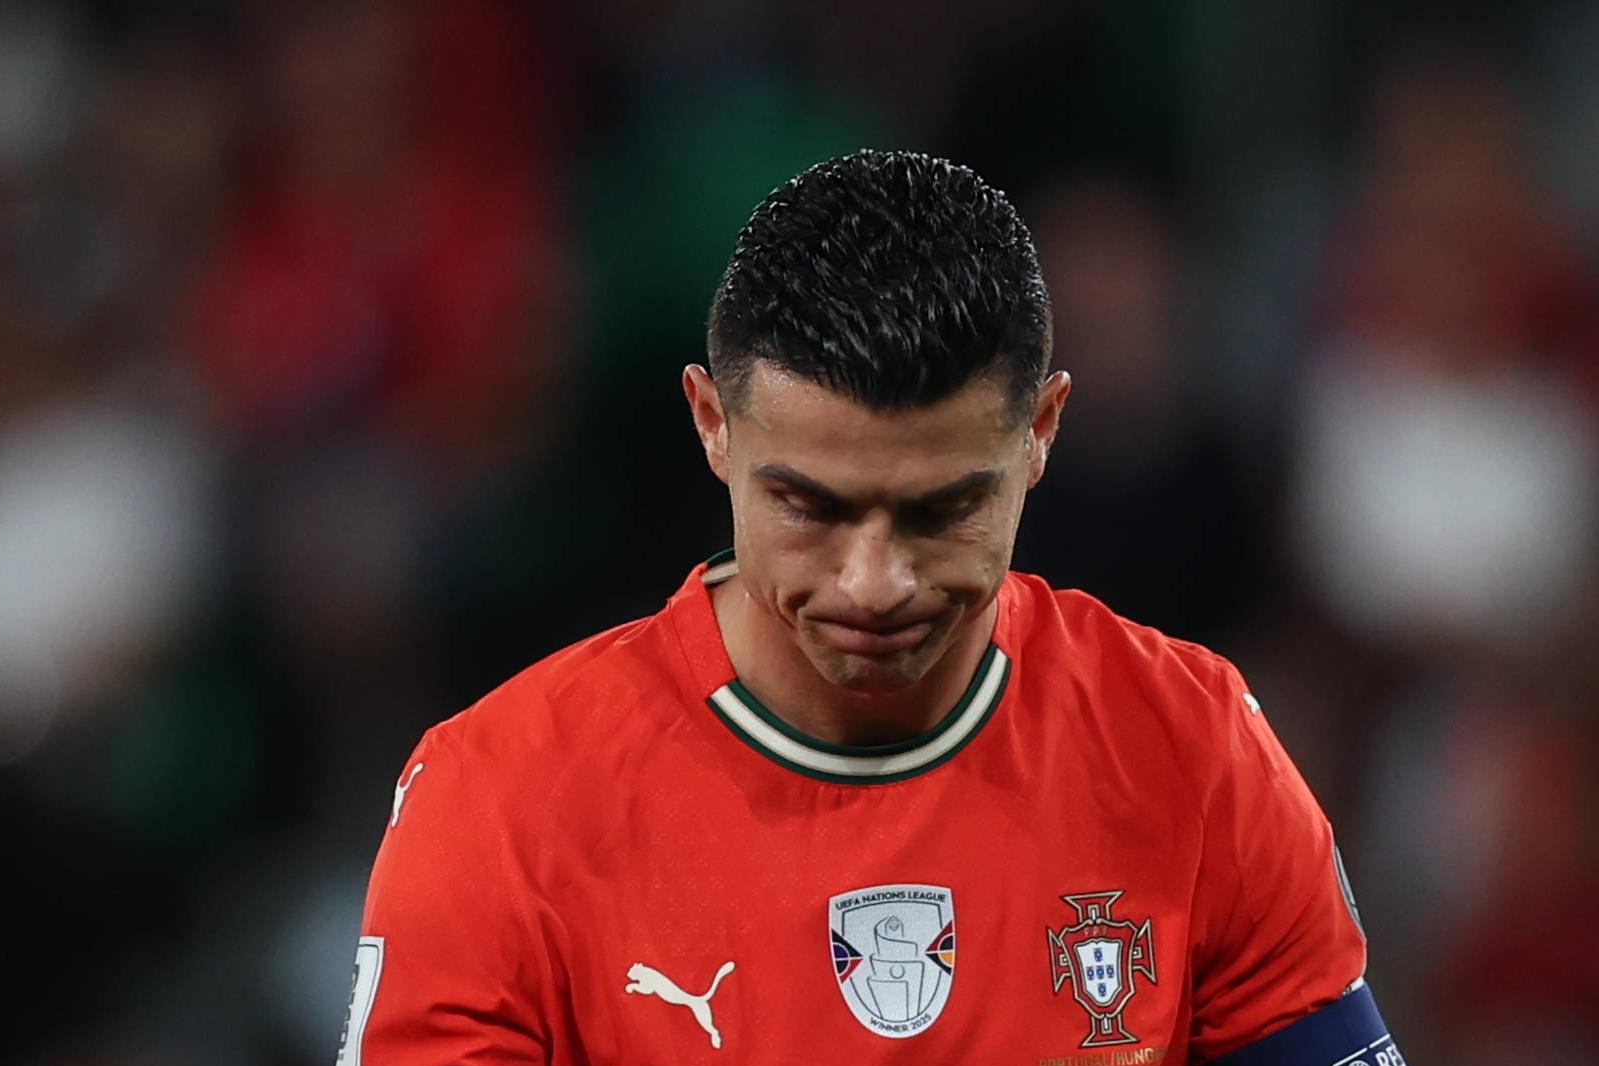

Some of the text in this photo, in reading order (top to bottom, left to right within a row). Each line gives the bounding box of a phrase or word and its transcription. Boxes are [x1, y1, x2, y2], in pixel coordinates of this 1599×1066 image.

[835, 890, 947, 911] UEFA NATIONS LEAGUE
[870, 1016, 908, 1032] WINNER
